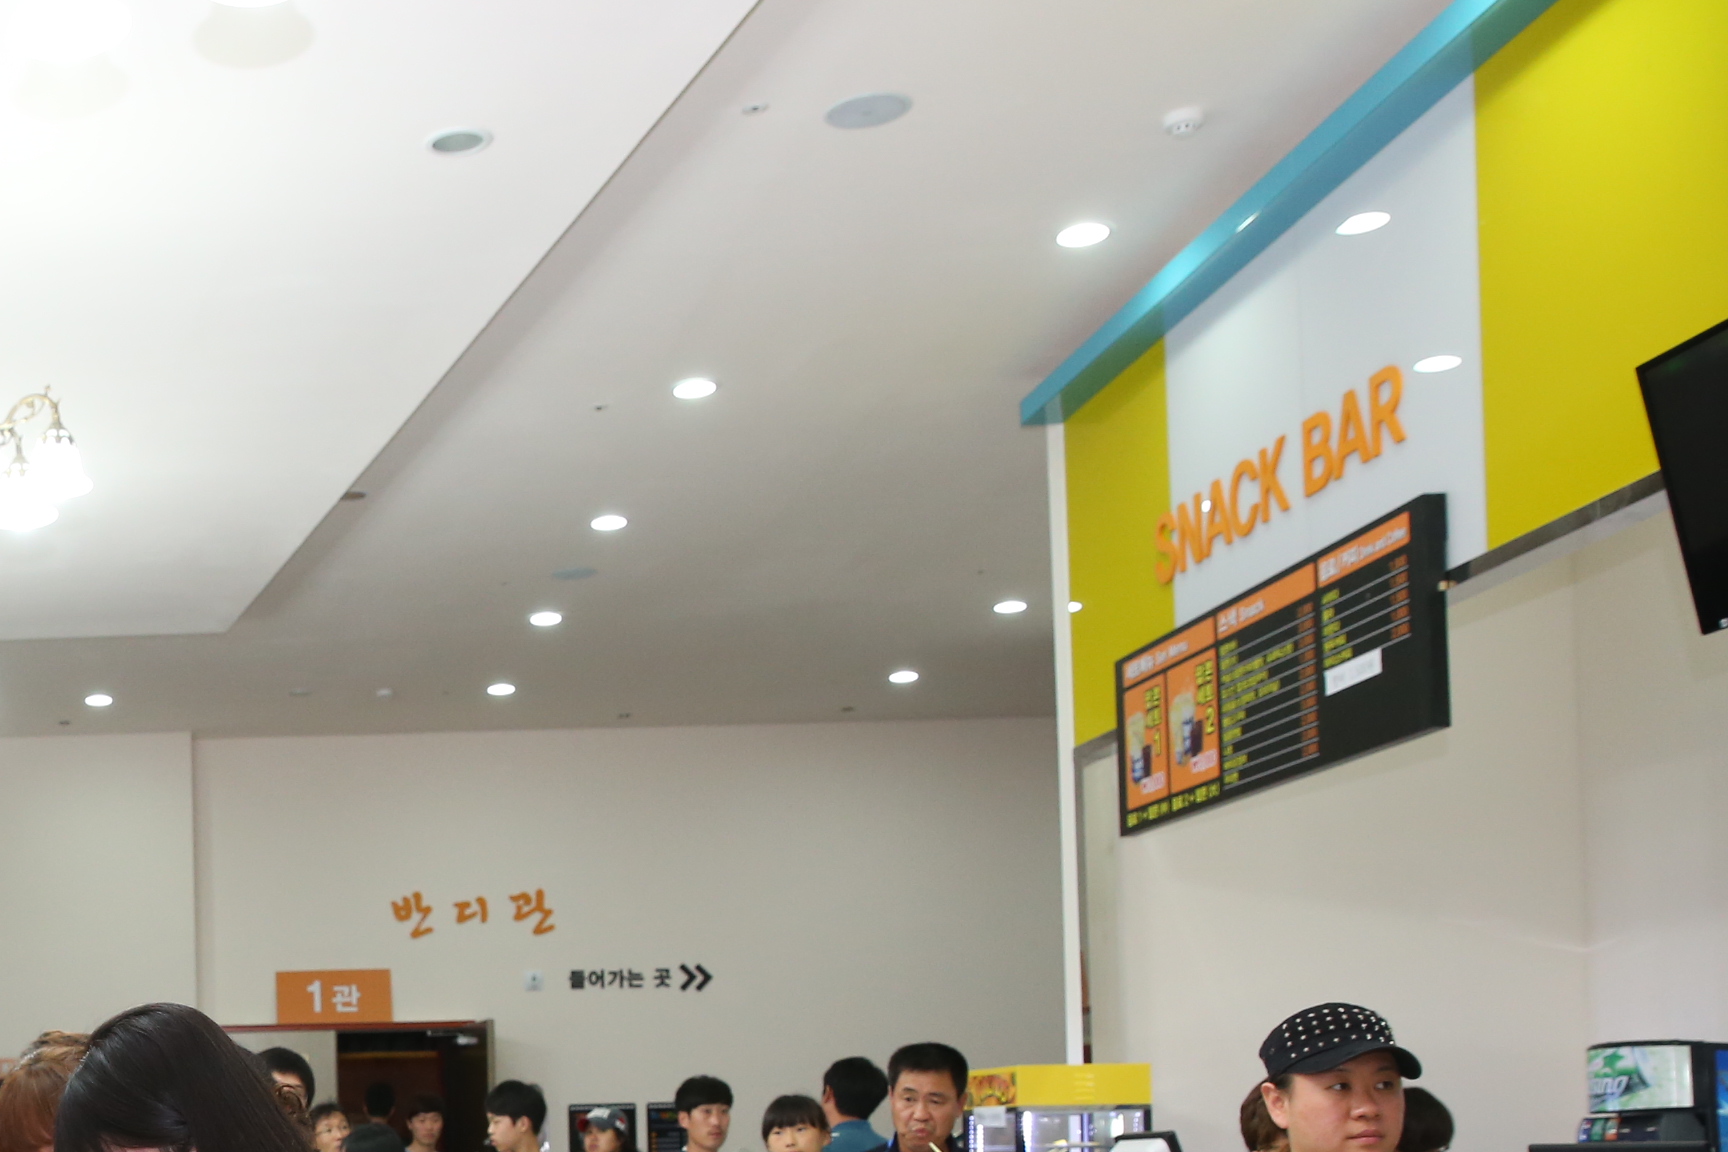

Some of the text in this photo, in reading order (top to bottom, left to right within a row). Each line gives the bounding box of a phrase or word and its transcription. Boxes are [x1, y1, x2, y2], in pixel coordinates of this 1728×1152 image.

[1154, 364, 1408, 587] SNACK BAR
[568, 967, 673, 991] 들어가는 곳
